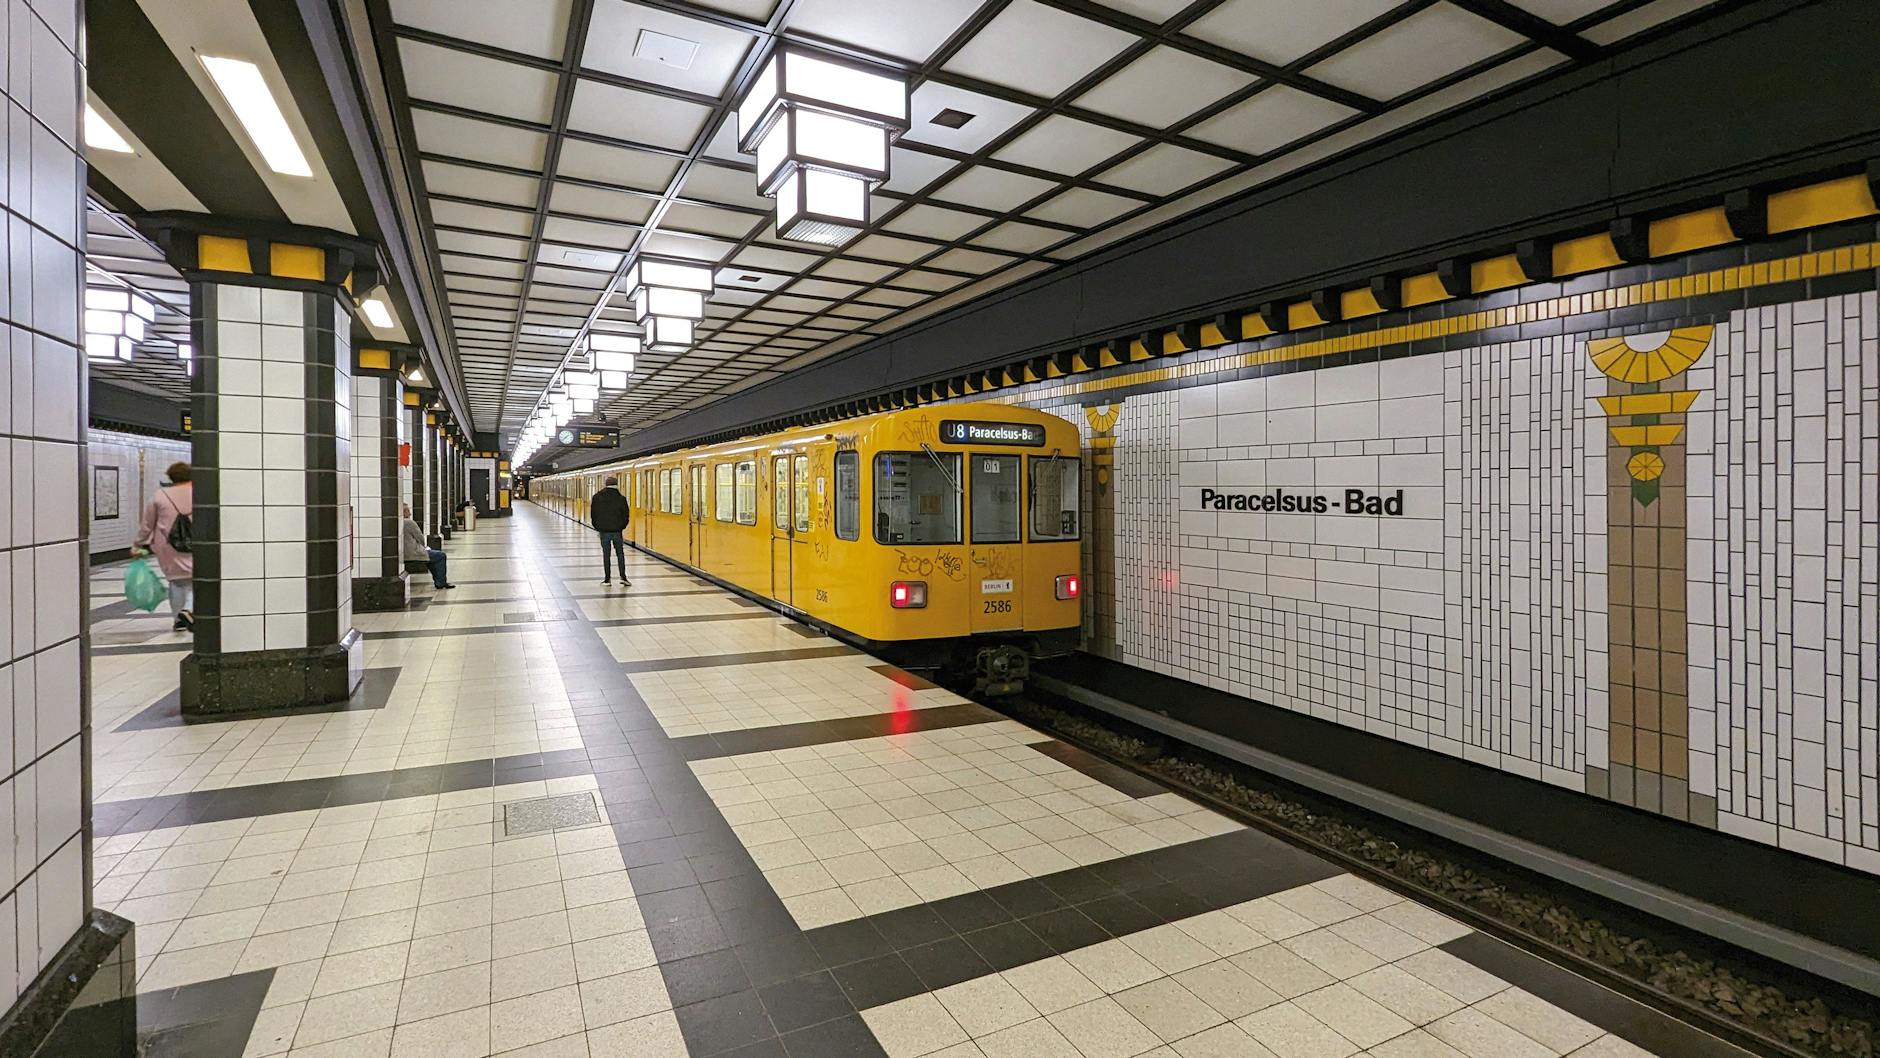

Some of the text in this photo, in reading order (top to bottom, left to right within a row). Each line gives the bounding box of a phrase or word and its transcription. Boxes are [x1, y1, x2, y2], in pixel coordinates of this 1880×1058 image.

[969, 425, 1038, 441] Paracelsus-Ba
[1201, 488, 1403, 516] Paracelsus-Bad
[983, 600, 1012, 614] 2586
